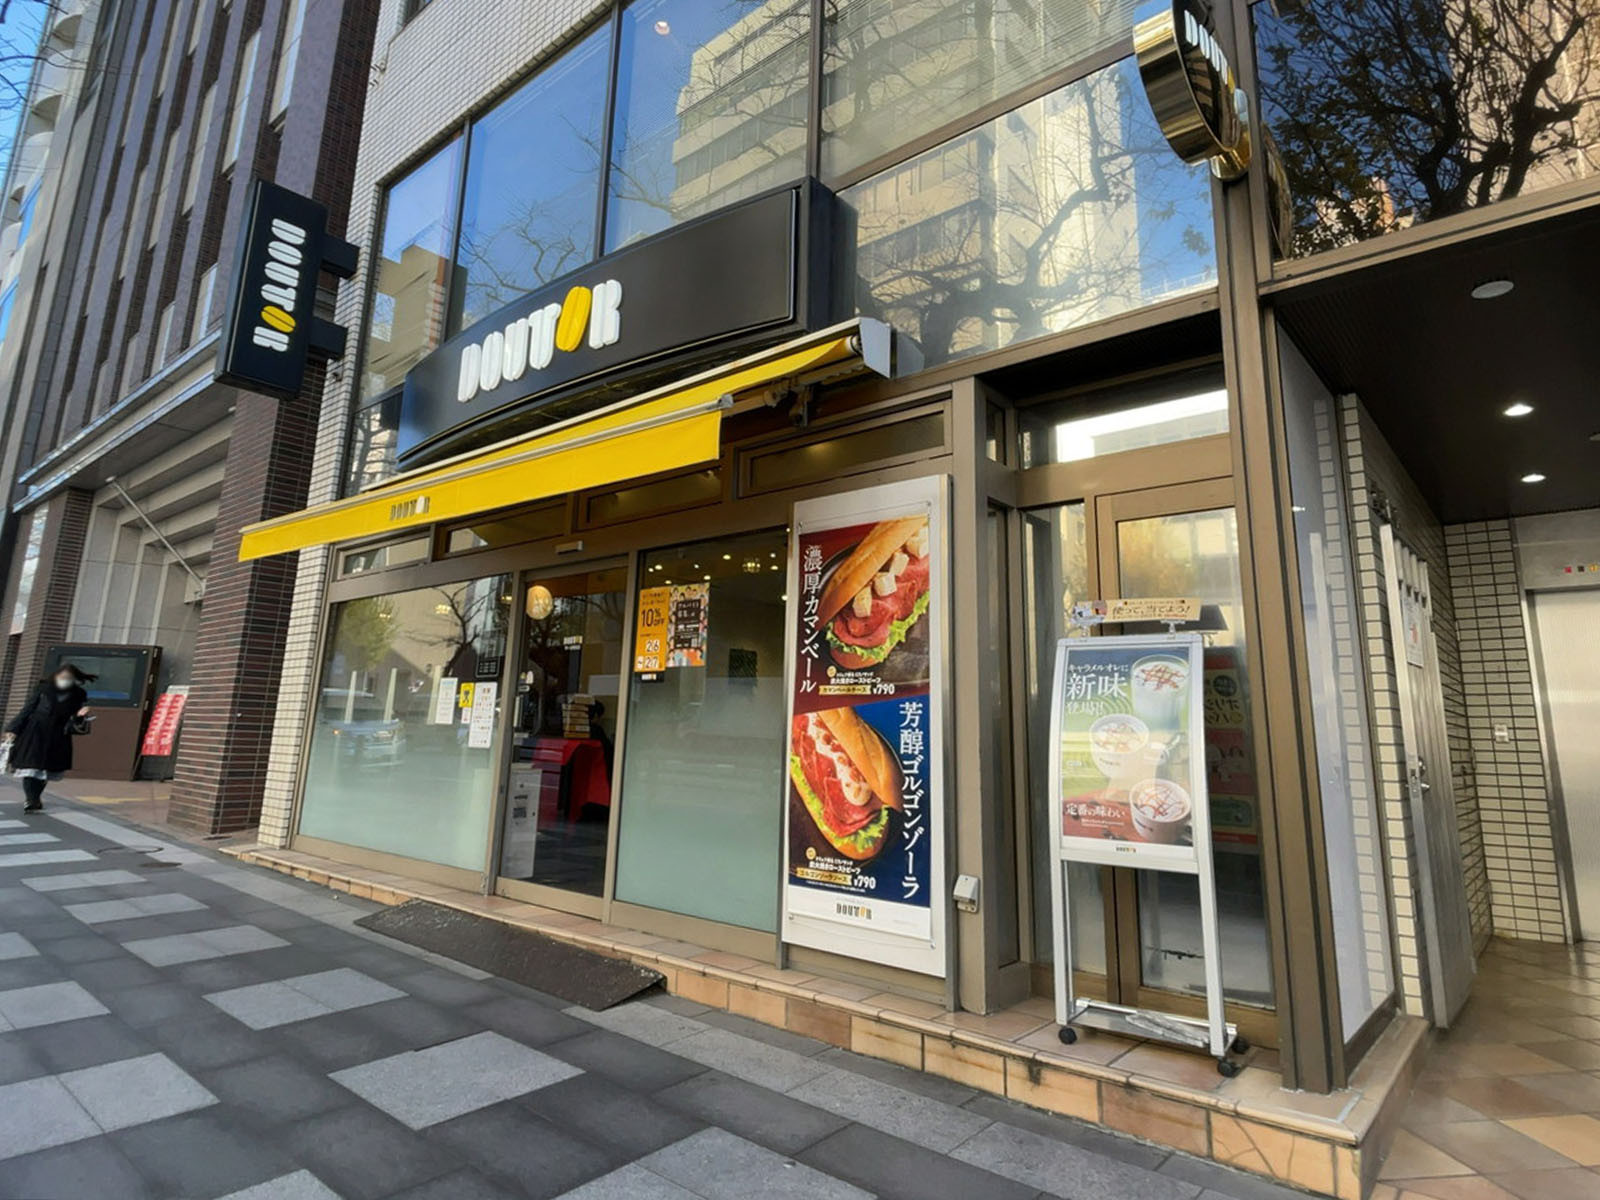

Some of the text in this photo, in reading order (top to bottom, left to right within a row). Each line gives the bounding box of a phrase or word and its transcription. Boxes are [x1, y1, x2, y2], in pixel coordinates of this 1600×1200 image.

[252, 217, 307, 353] DOUTOR
[456, 279, 623, 404] DOUTOR
[389, 495, 432, 522] DOUTOR
[799, 544, 823, 694] 濃厚カマンベール
[1067, 663, 1129, 673] キャラメルオレに
[873, 683, 895, 695] ¥790
[1066, 672, 1128, 701] 新味
[899, 701, 925, 900] 芳醇ゴルゴンゾーラ
[853, 875, 877, 890] ¥790
[836, 903, 873, 920] DOUTOR
